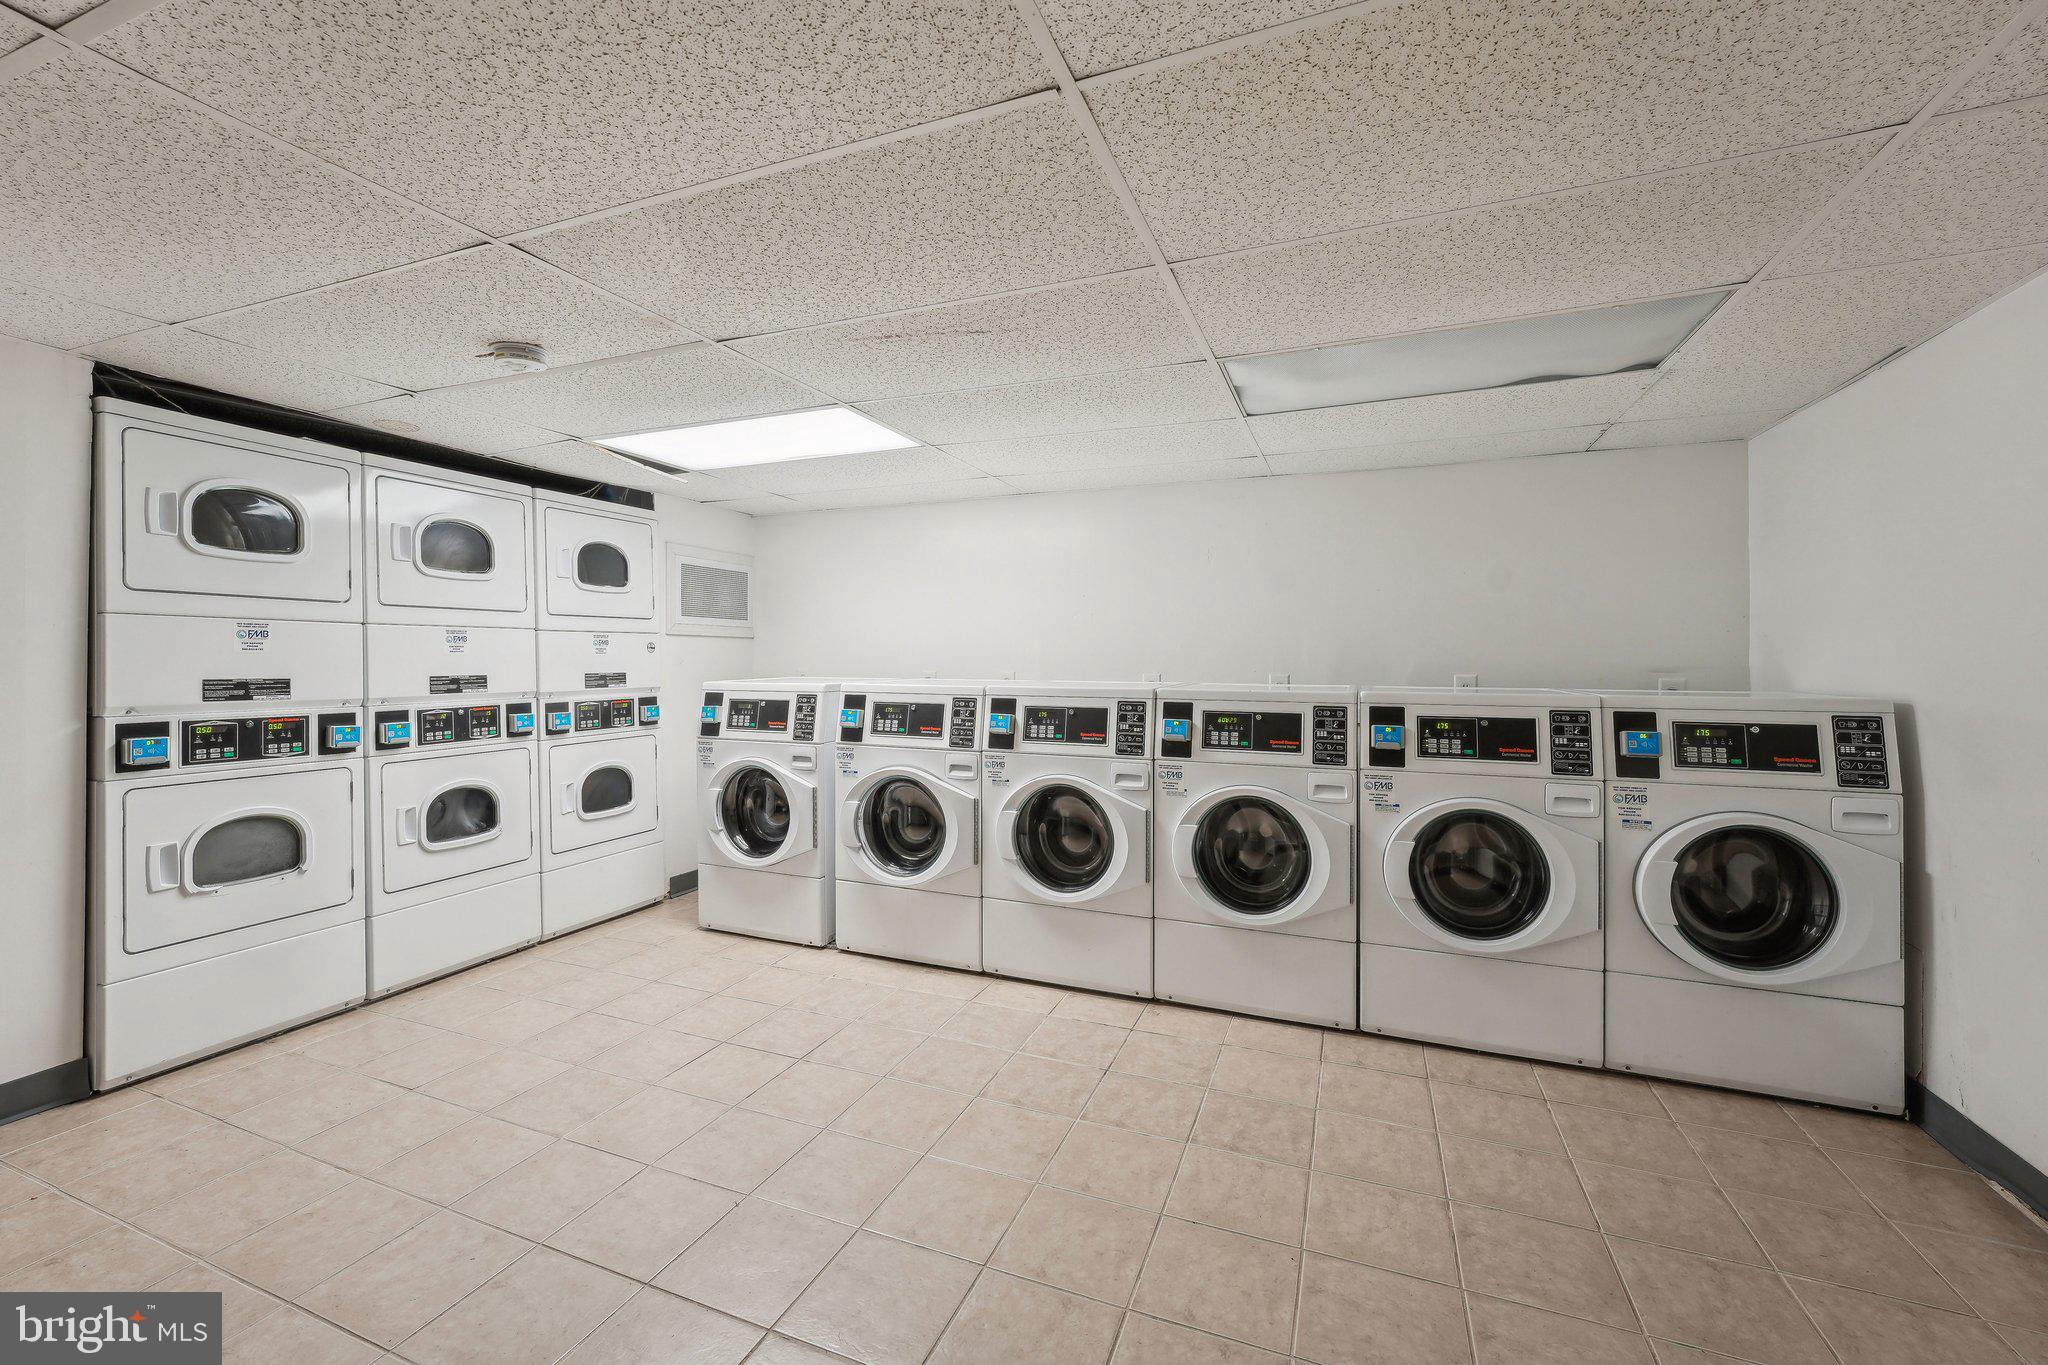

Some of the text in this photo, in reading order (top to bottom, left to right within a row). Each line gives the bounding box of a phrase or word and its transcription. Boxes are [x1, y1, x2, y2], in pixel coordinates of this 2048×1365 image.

[248, 630, 270, 640] FMB
[992, 760, 1006, 769] FMB
[1166, 771, 1183, 780] FMB
[1374, 781, 1393, 791] FMB
[1624, 793, 1648, 804] FMB
